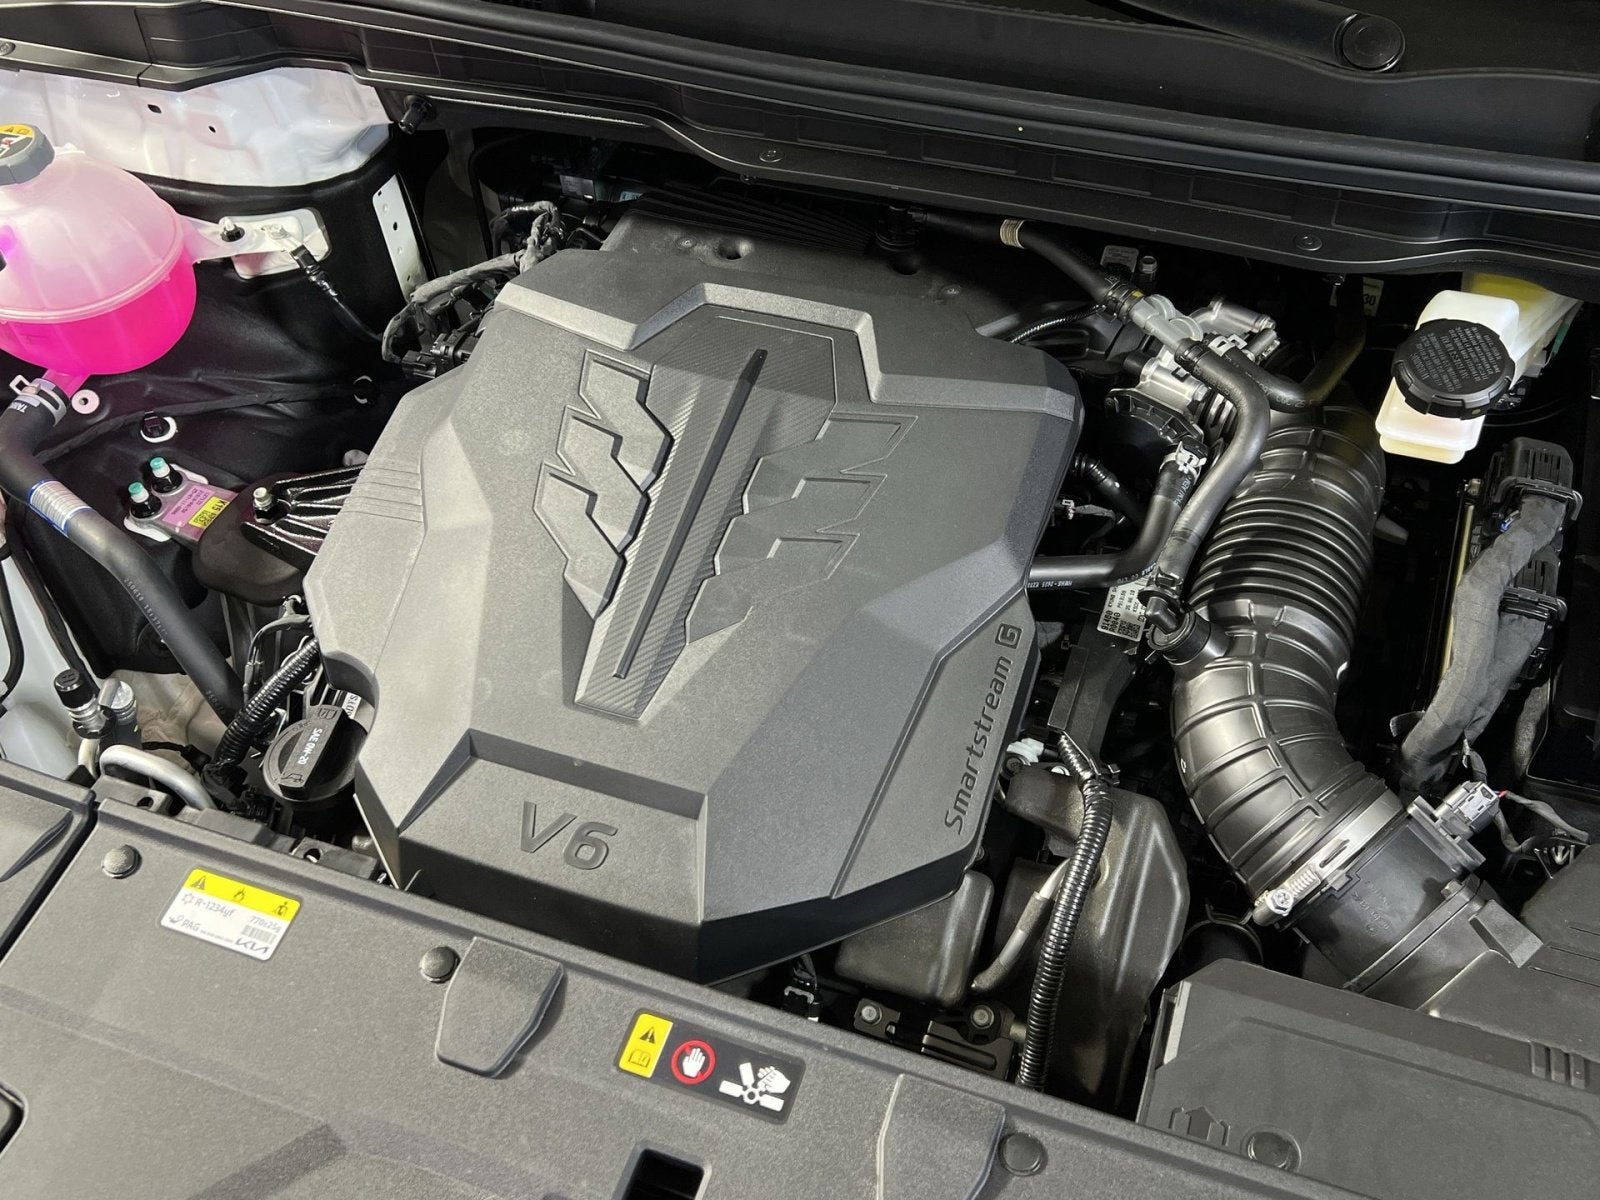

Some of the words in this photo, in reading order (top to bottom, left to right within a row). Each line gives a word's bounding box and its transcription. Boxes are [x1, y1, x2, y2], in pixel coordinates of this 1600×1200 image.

[296, 741, 316, 766] 0W-20
[307, 727, 323, 743] SAE
[944, 655, 1014, 836] Smartstream
[520, 800, 619, 871] V6
